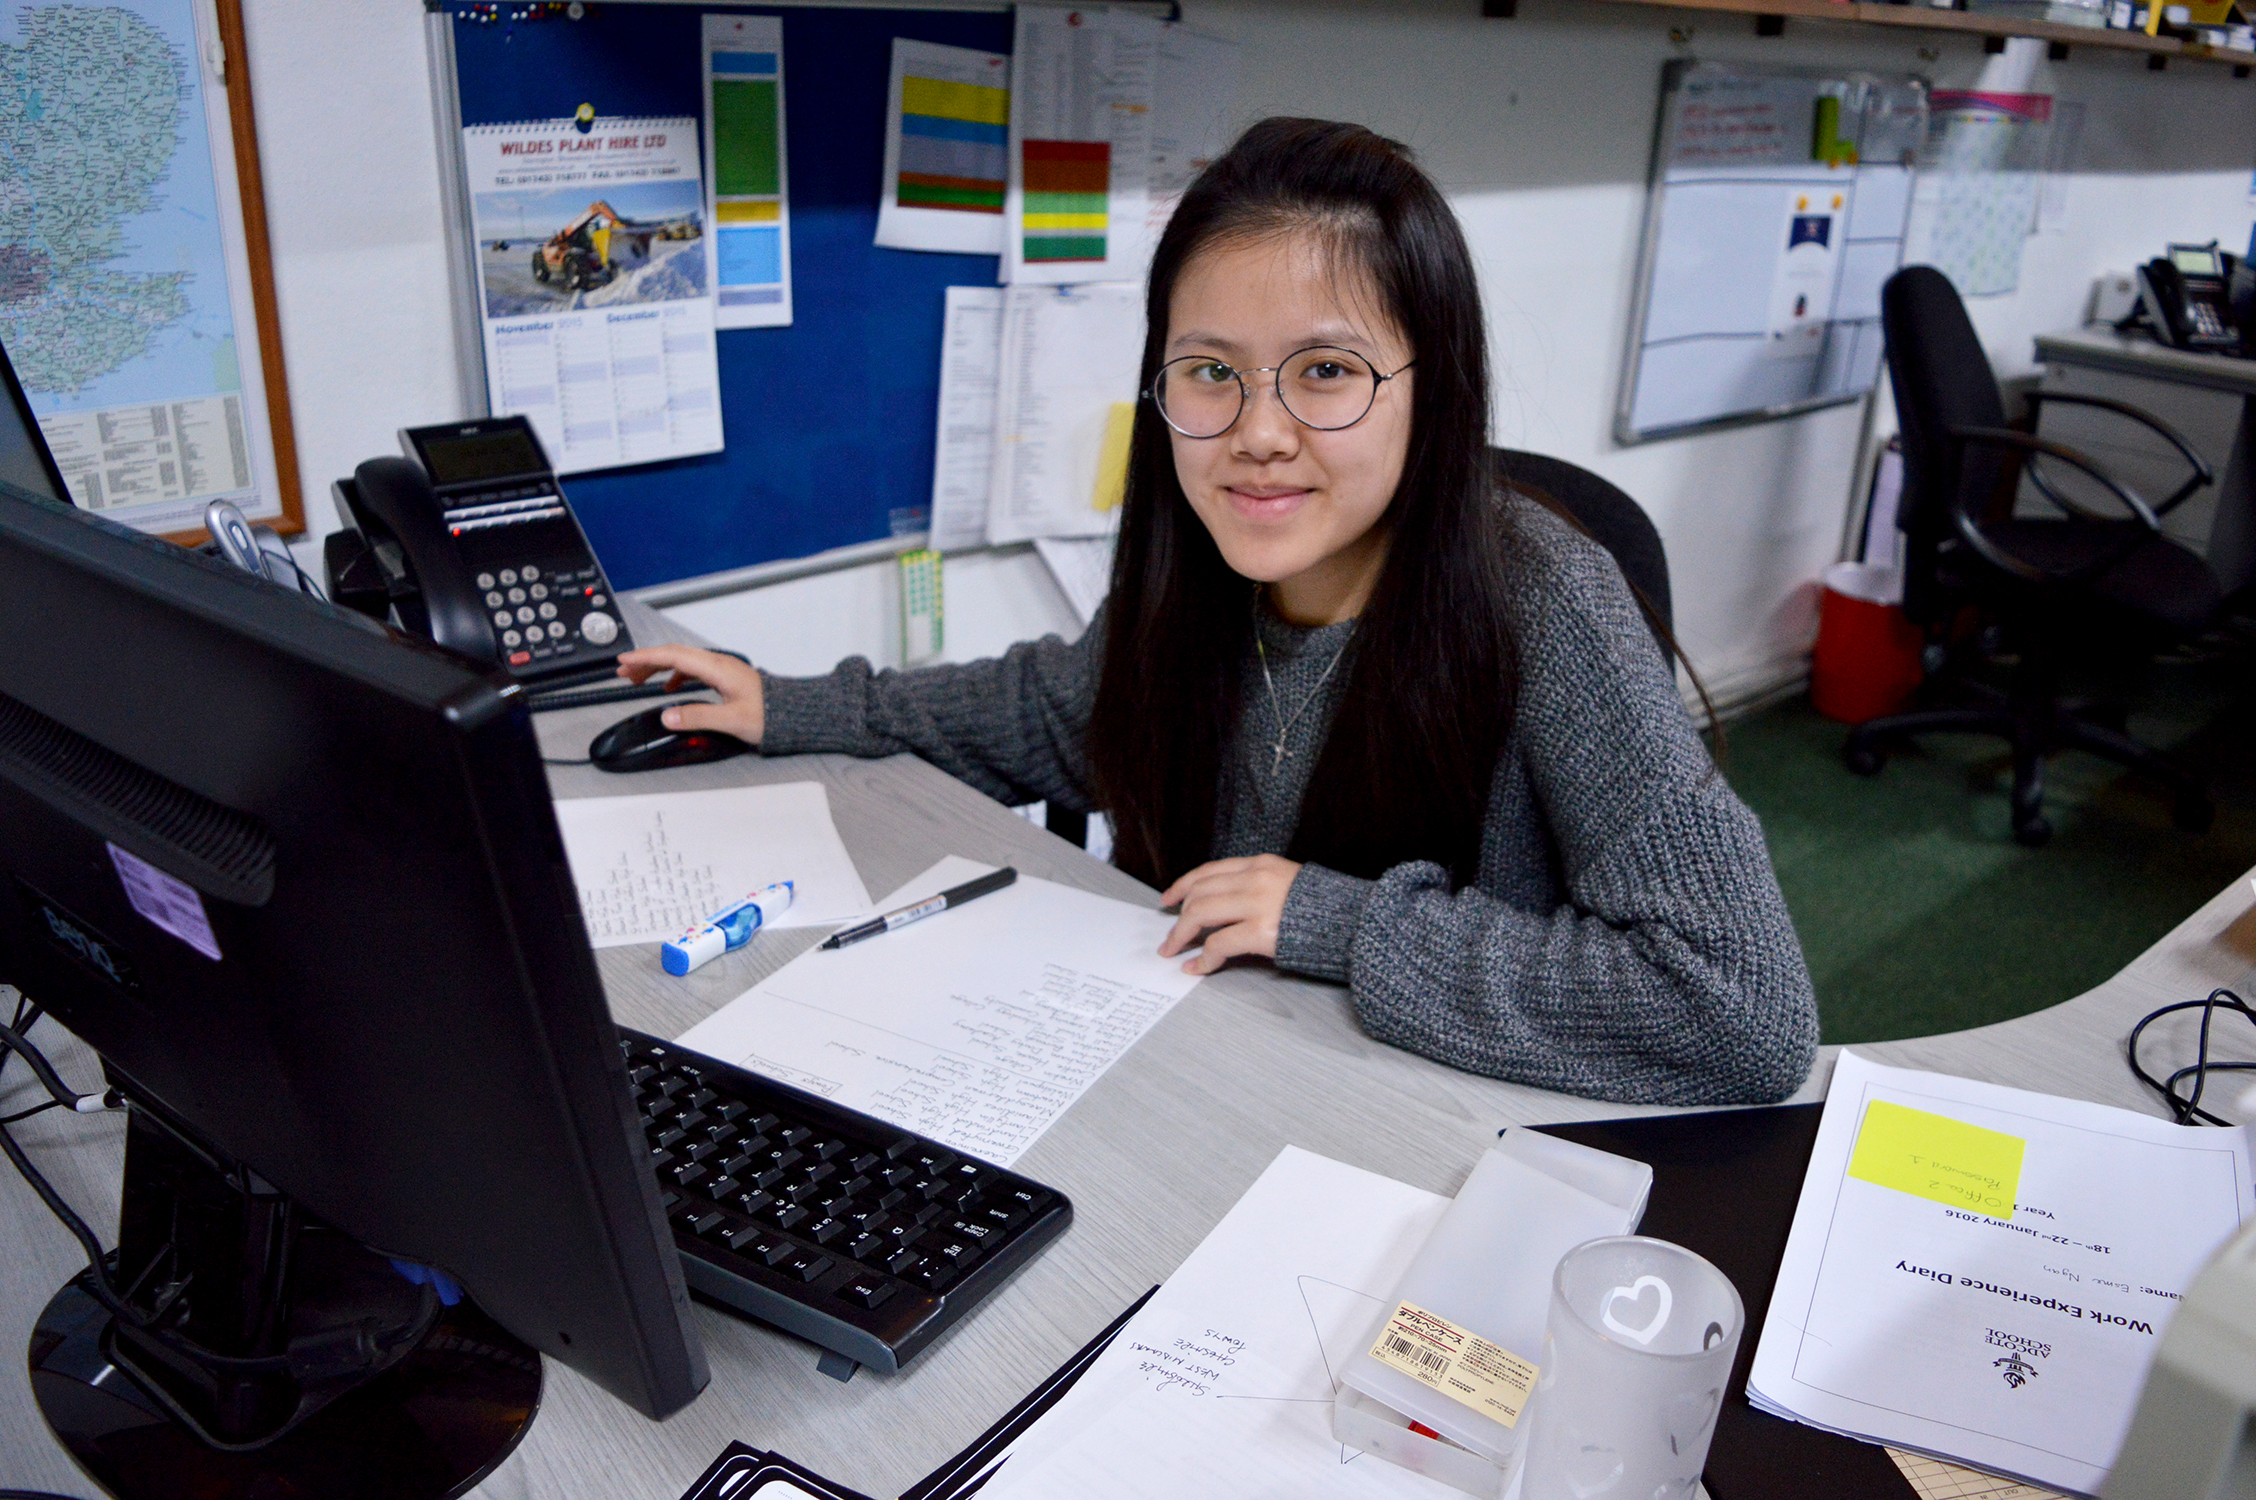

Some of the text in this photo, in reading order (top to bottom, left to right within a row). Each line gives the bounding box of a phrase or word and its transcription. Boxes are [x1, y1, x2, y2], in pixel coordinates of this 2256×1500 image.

[501, 134, 667, 155] WILDES PLANT HIRE LTD
[607, 310, 660, 323] December
[496, 321, 553, 335] November
[1932, 1161, 2002, 1190] Password
[1015, 1191, 1032, 1201] Ctrl
[989, 1209, 1009, 1219] Shift
[1945, 1209, 1980, 1224] 2016
[2023, 1206, 2055, 1220] Year
[963, 1226, 985, 1238] Caps
[969, 1223, 990, 1234] Lock
[1983, 1217, 2040, 1238] January
[943, 1246, 958, 1257] Tab
[794, 1260, 806, 1269] F1
[855, 1285, 872, 1296] Esc
[1895, 1259, 2154, 1335] Work Experience Diary
[1398, 1308, 1462, 1346] ダブルペンケース
[1410, 1323, 1442, 1342] PEN CASE
[1985, 1327, 2052, 1351] SCHOOL
[1984, 1335, 2051, 1359] ADCOTE
[1185, 1364, 1219, 1381] WEST
